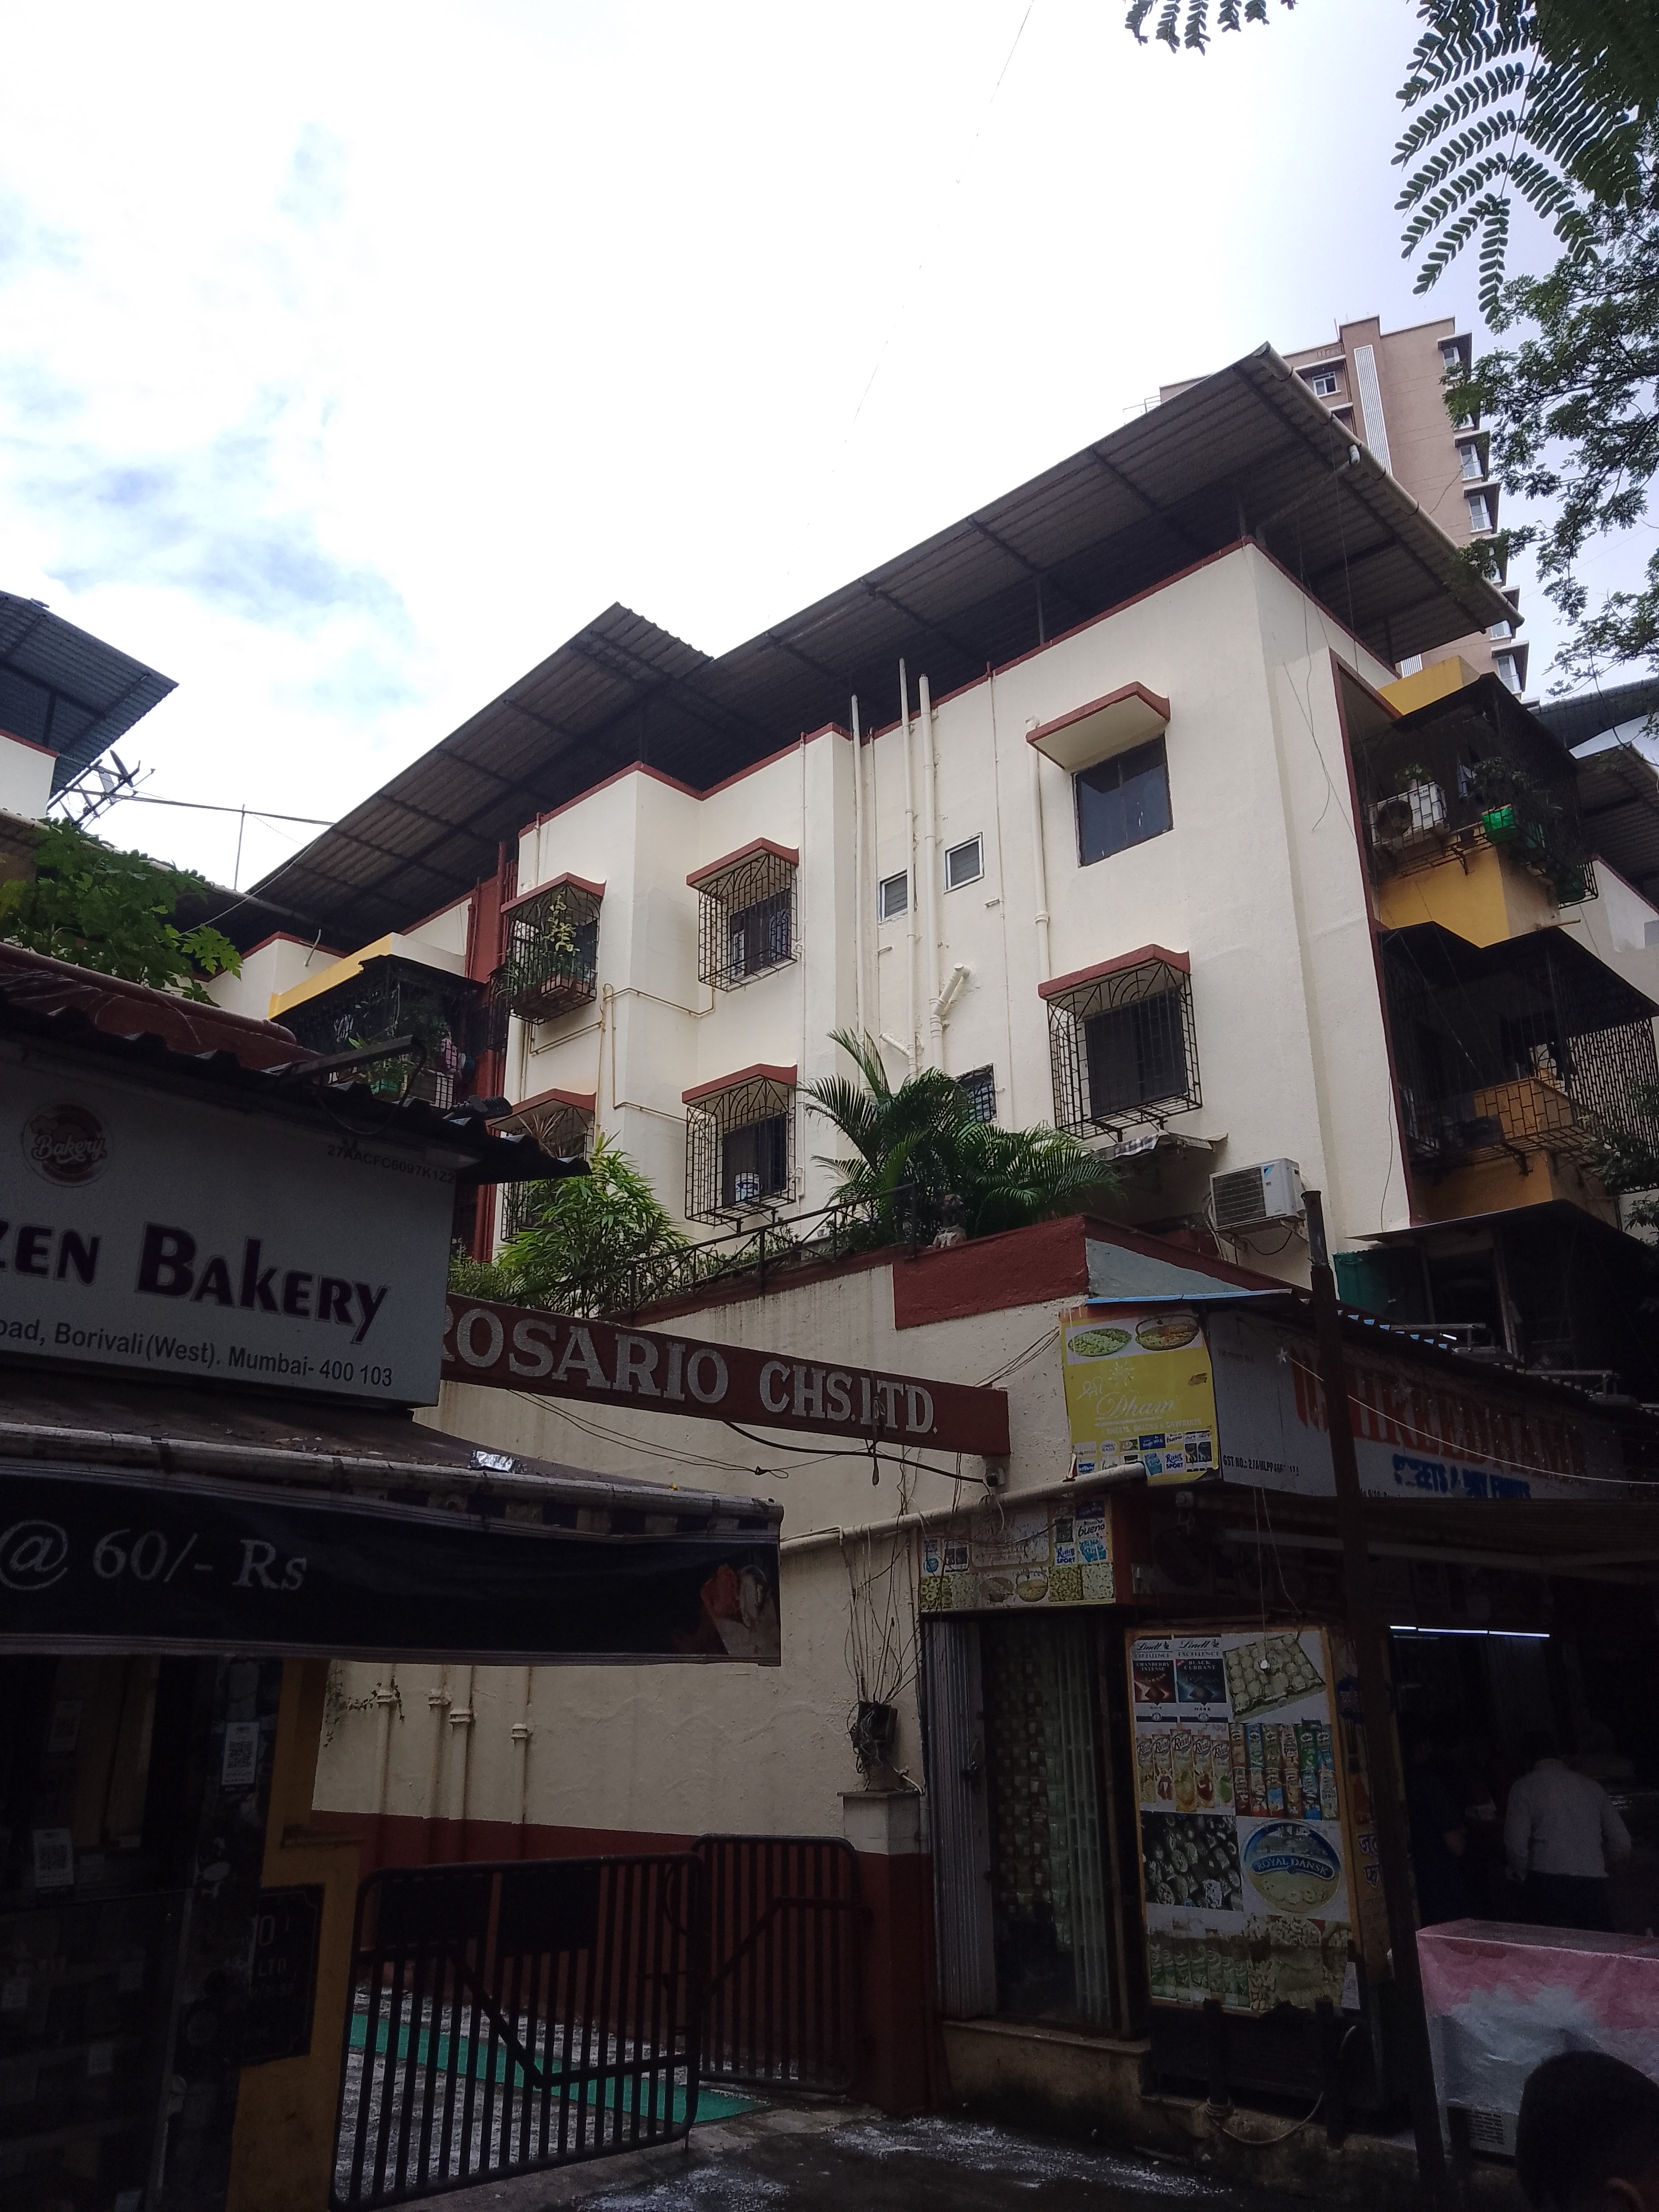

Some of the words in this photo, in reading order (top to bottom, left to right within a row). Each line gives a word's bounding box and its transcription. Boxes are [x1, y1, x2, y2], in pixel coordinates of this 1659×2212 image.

[31, 1134, 107, 1164] Bakery
[319, 1359, 354, 1381] 400
[360, 1364, 392, 1387] 103
[1096, 1390, 1176, 1419] Dham
[1223, 1455, 1234, 1467] GST
[1078, 1523, 1105, 1537] bueno
[92, 1529, 213, 1582] 60/-
[232, 1539, 307, 1591] Rs
[1137, 1642, 1162, 1650] Lindt
[1180, 1640, 1211, 1649] Lindt
[1256, 1857, 1289, 1870] ROYAL
[1291, 1858, 1328, 1875] DANSK
